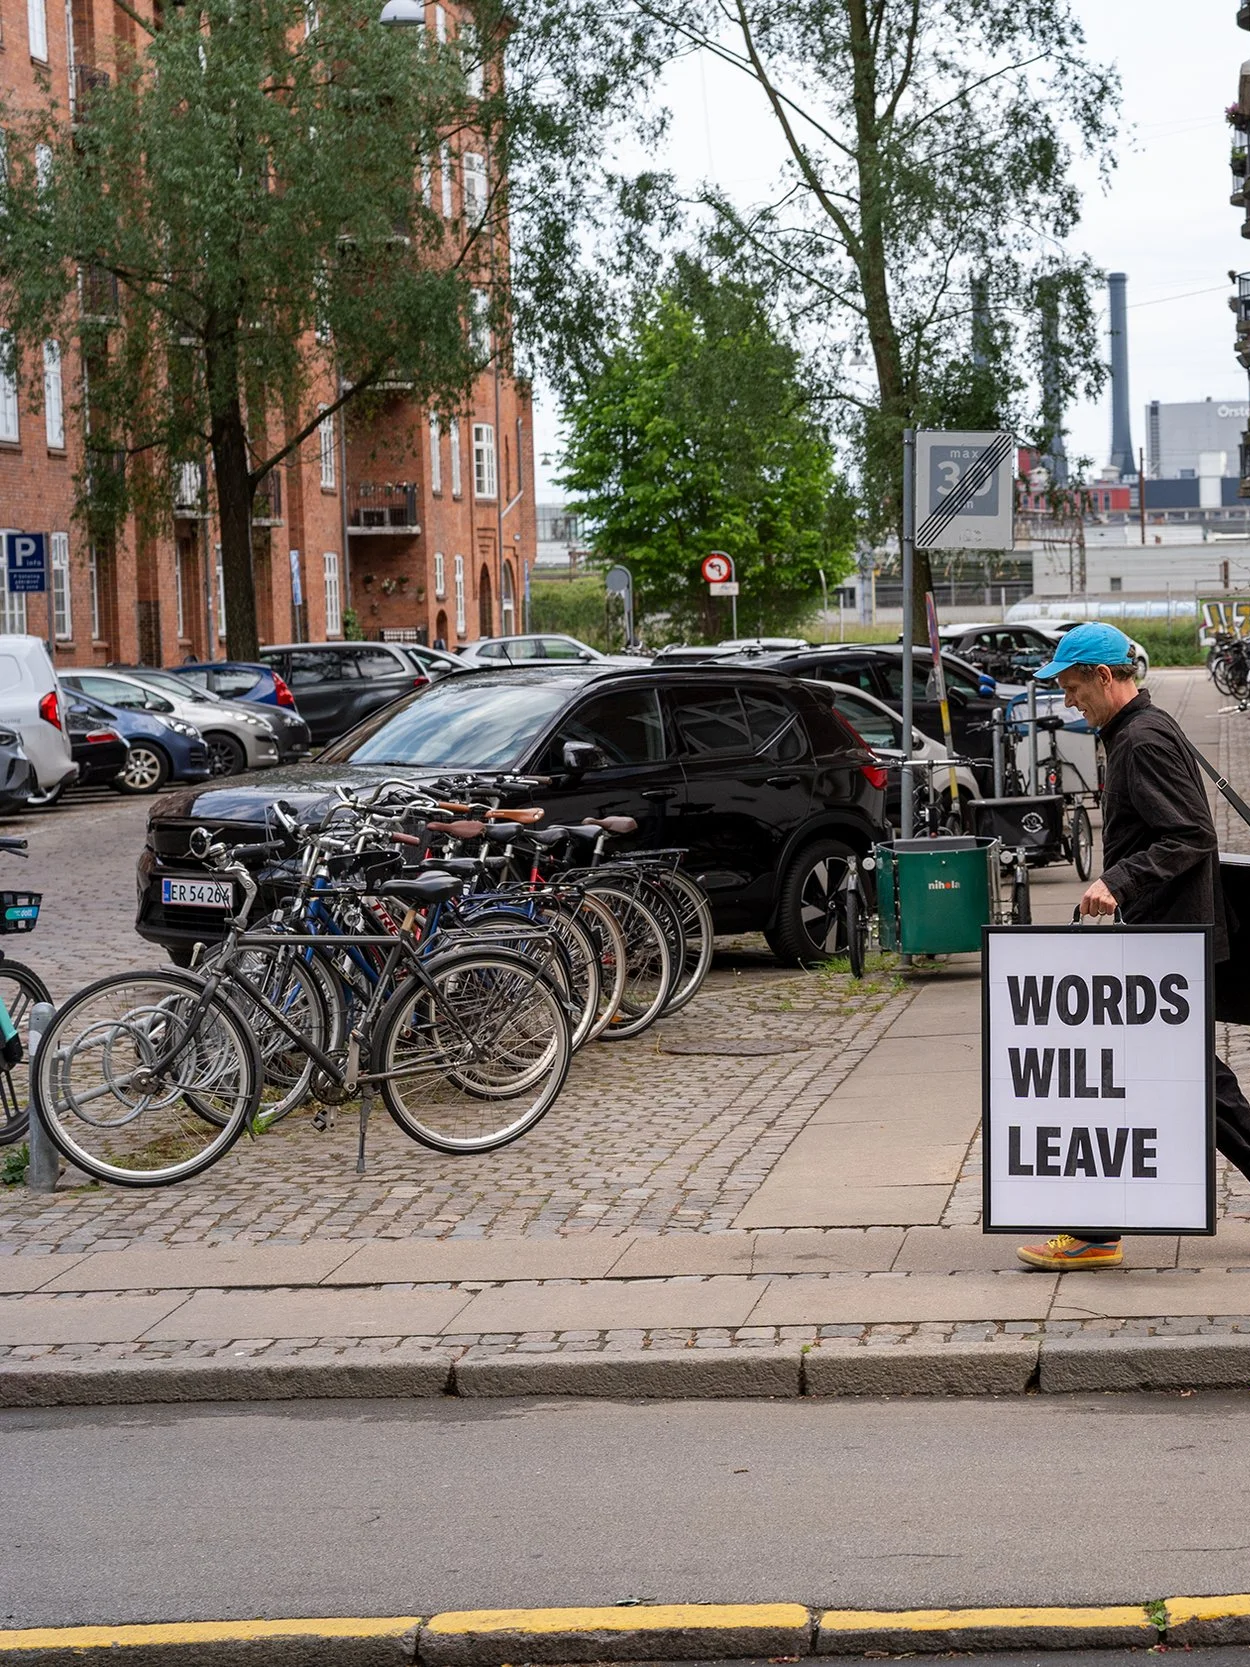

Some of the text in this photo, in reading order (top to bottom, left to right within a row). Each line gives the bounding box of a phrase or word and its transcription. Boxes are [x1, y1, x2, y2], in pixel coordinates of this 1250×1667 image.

[950, 449, 979, 459] max
[936, 461, 993, 497] 30
[15, 537, 36, 567] P
[171, 885, 186, 901] ER
[190, 886, 204, 902] 54
[928, 880, 960, 890] nihola
[1007, 973, 1190, 1026] WORDS
[1008, 1047, 1126, 1099] WILL
[1008, 1125, 1158, 1179] LEAVE
